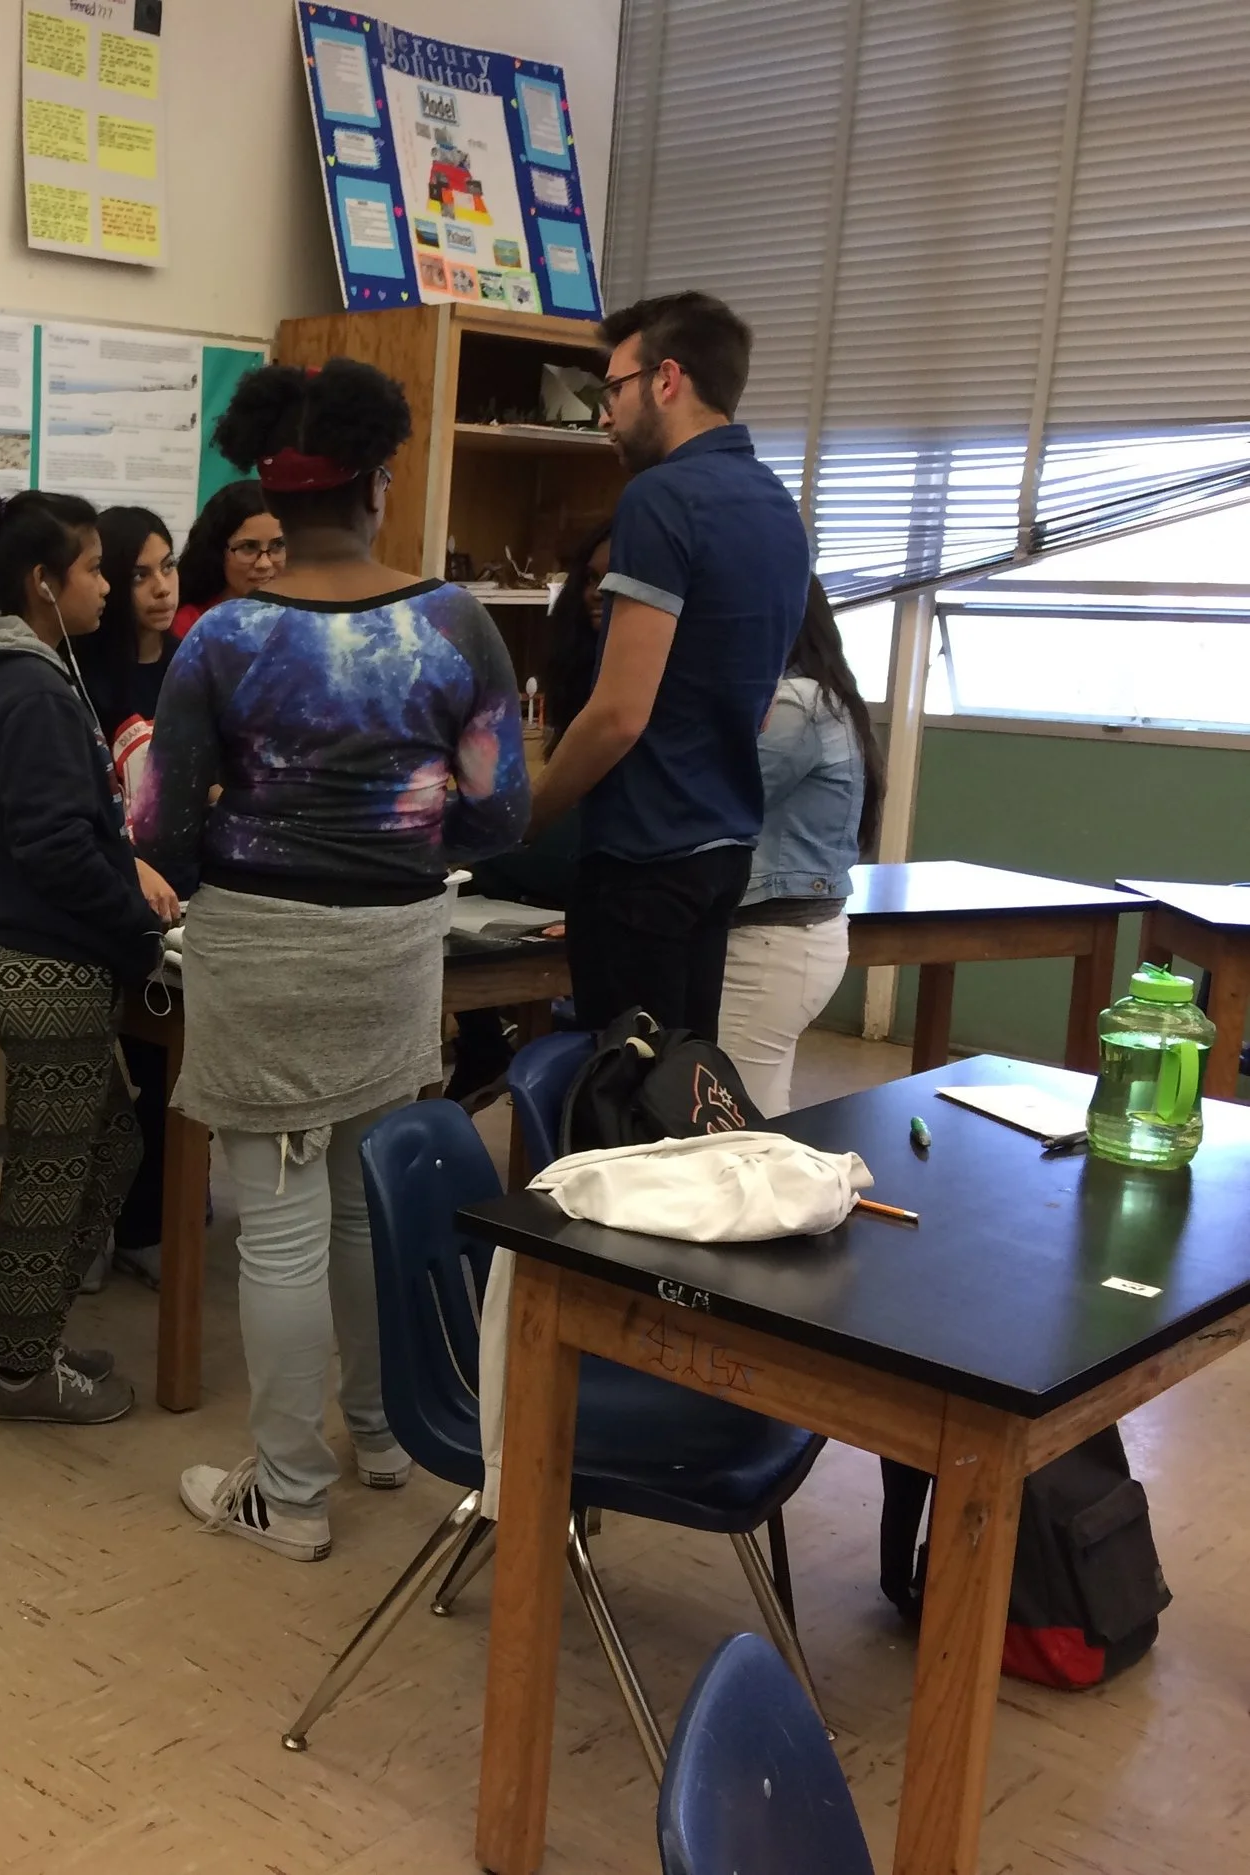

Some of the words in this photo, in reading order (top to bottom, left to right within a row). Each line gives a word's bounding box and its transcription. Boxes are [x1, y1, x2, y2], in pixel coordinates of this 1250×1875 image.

[377, 20, 491, 78] Mercury
[383, 46, 494, 95] Pollution
[419, 91, 456, 121] Model
